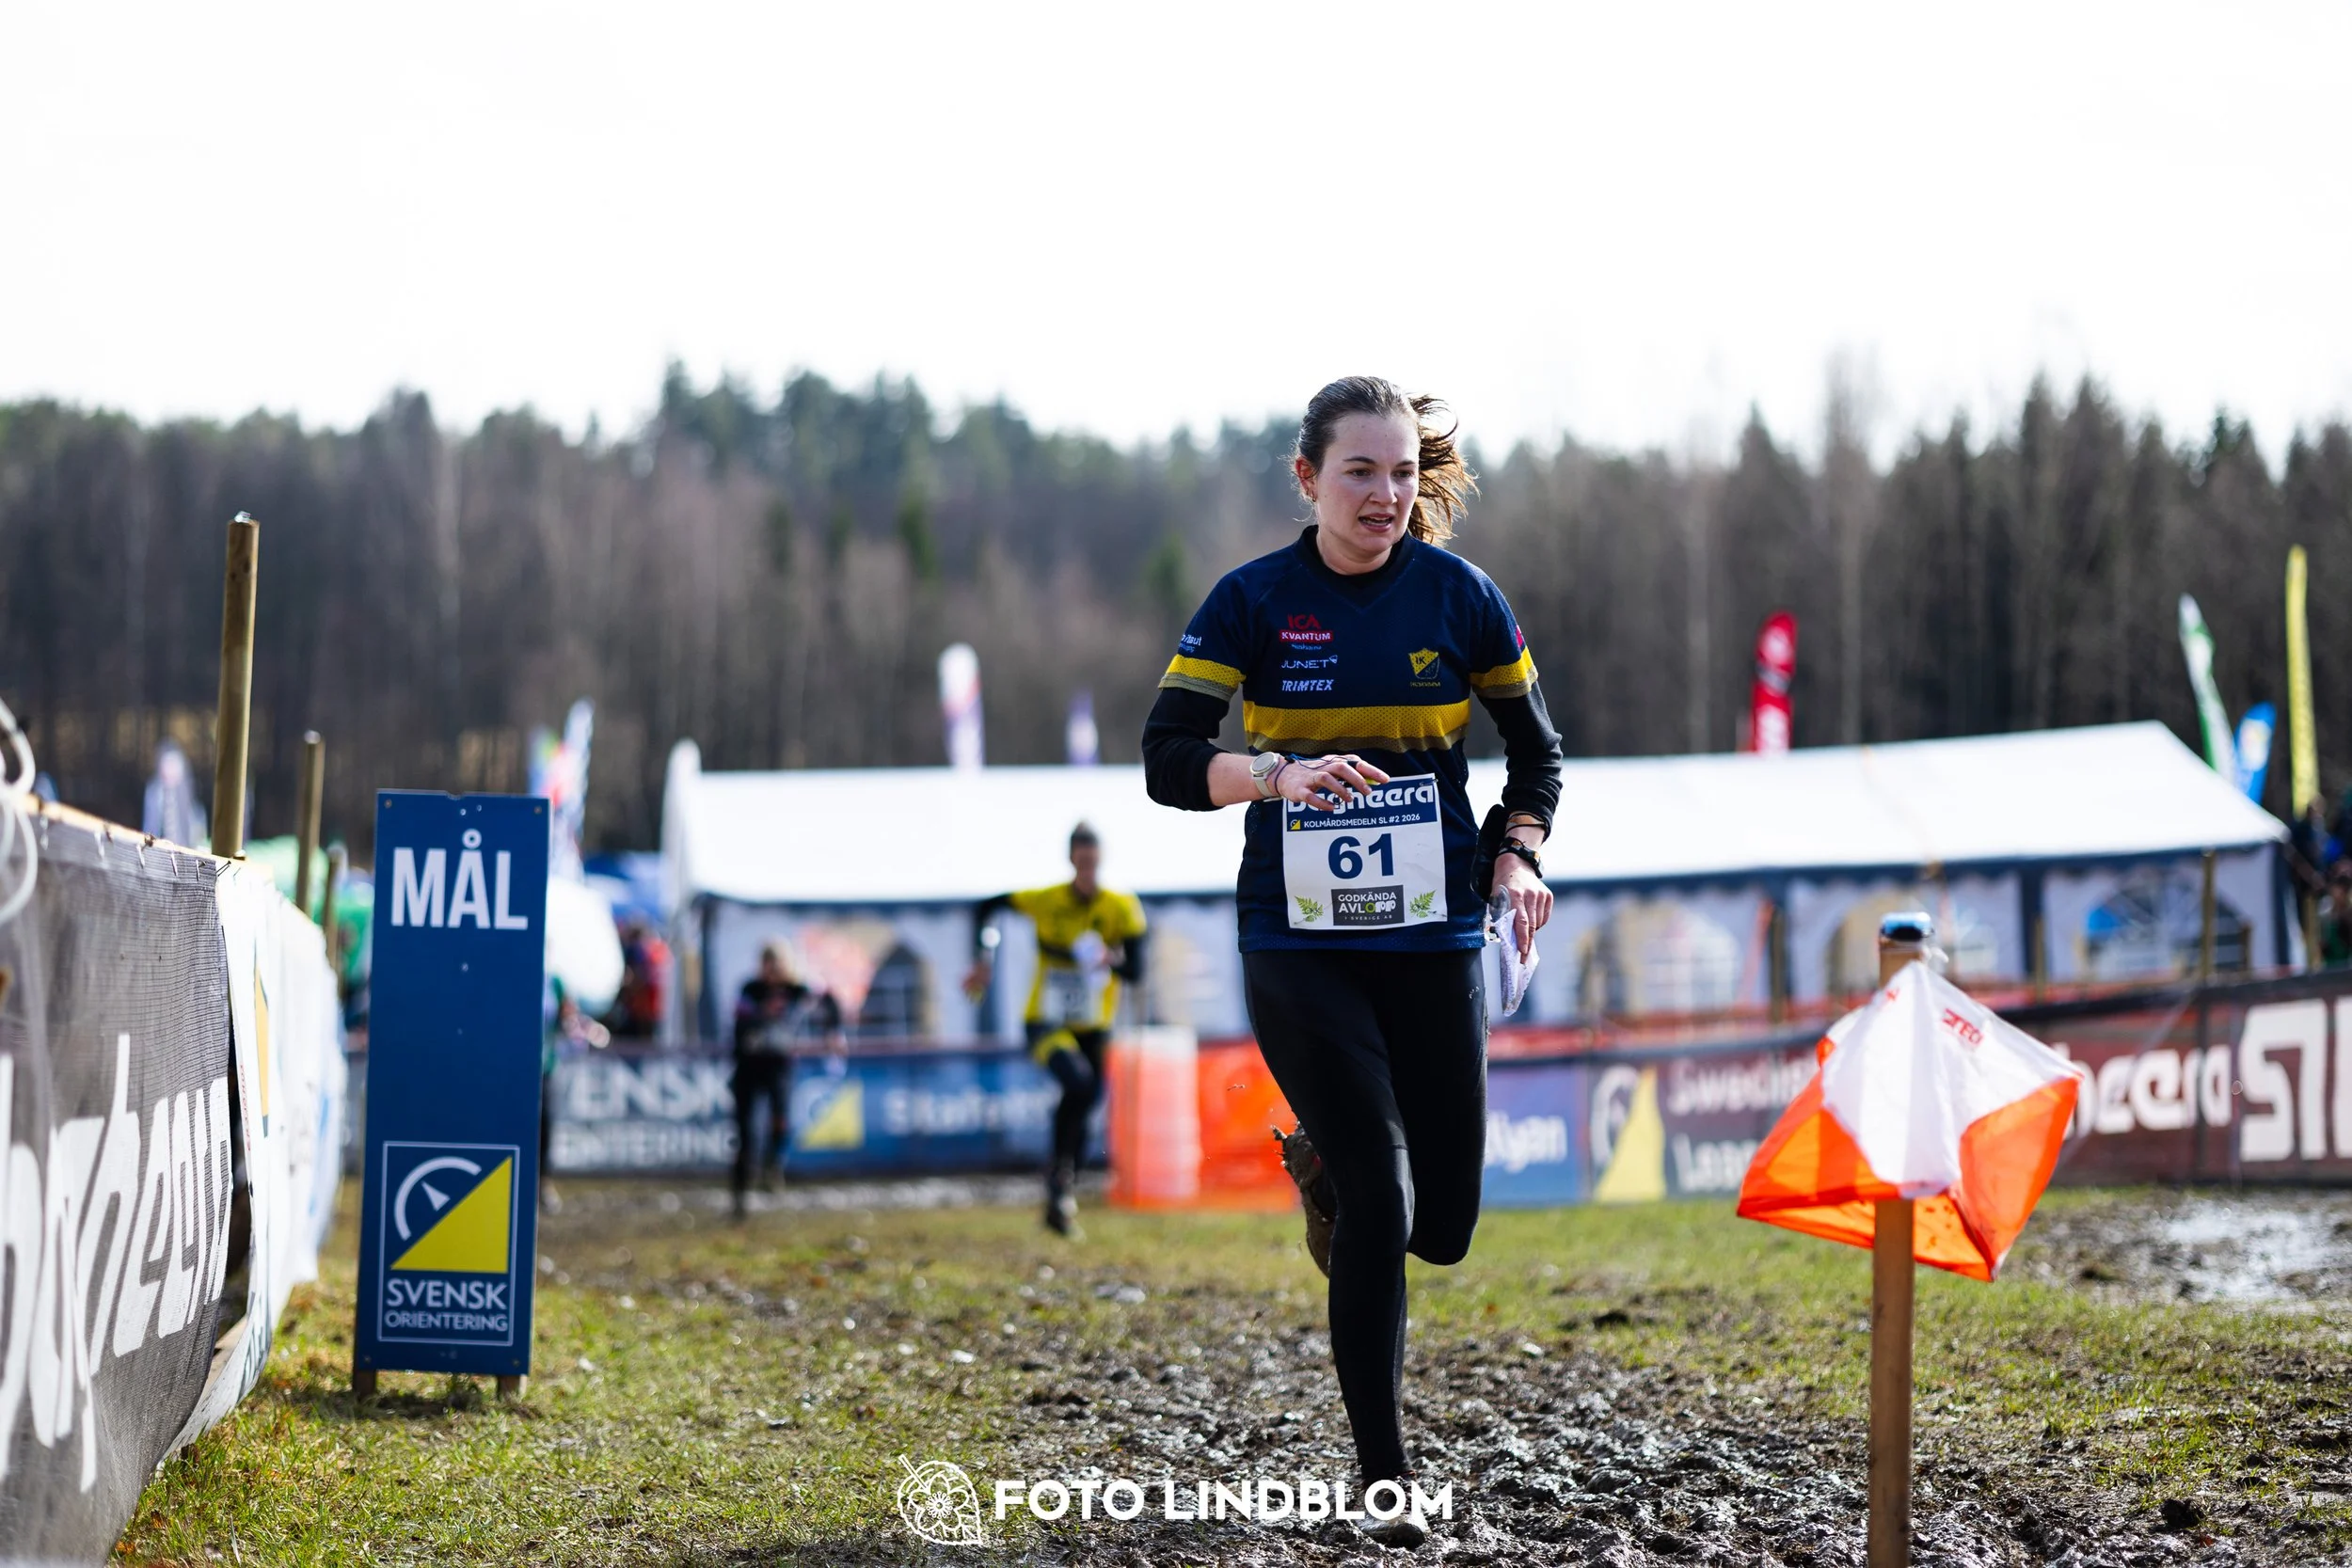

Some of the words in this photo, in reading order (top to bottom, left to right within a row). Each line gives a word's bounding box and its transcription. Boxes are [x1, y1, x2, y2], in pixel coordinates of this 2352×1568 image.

[1287, 613, 1322, 630] ICA
[1281, 631, 1331, 641] KVANTUM
[1281, 659, 1329, 669] JUNET
[1281, 679, 1334, 691] TRIMTEX
[1304, 817, 1377, 829] KOLMÅRDSMEDELN
[1378, 816, 1388, 825] SL
[1389, 815, 1400, 824] #2
[1399, 813, 1421, 822] 2026
[1327, 832, 1394, 879] 61
[391, 829, 529, 930] MÅL
[1338, 892, 1397, 902] GODKÄNDA
[386, 1277, 508, 1310] SVENSK
[384, 1309, 509, 1332] ORIENTERING
